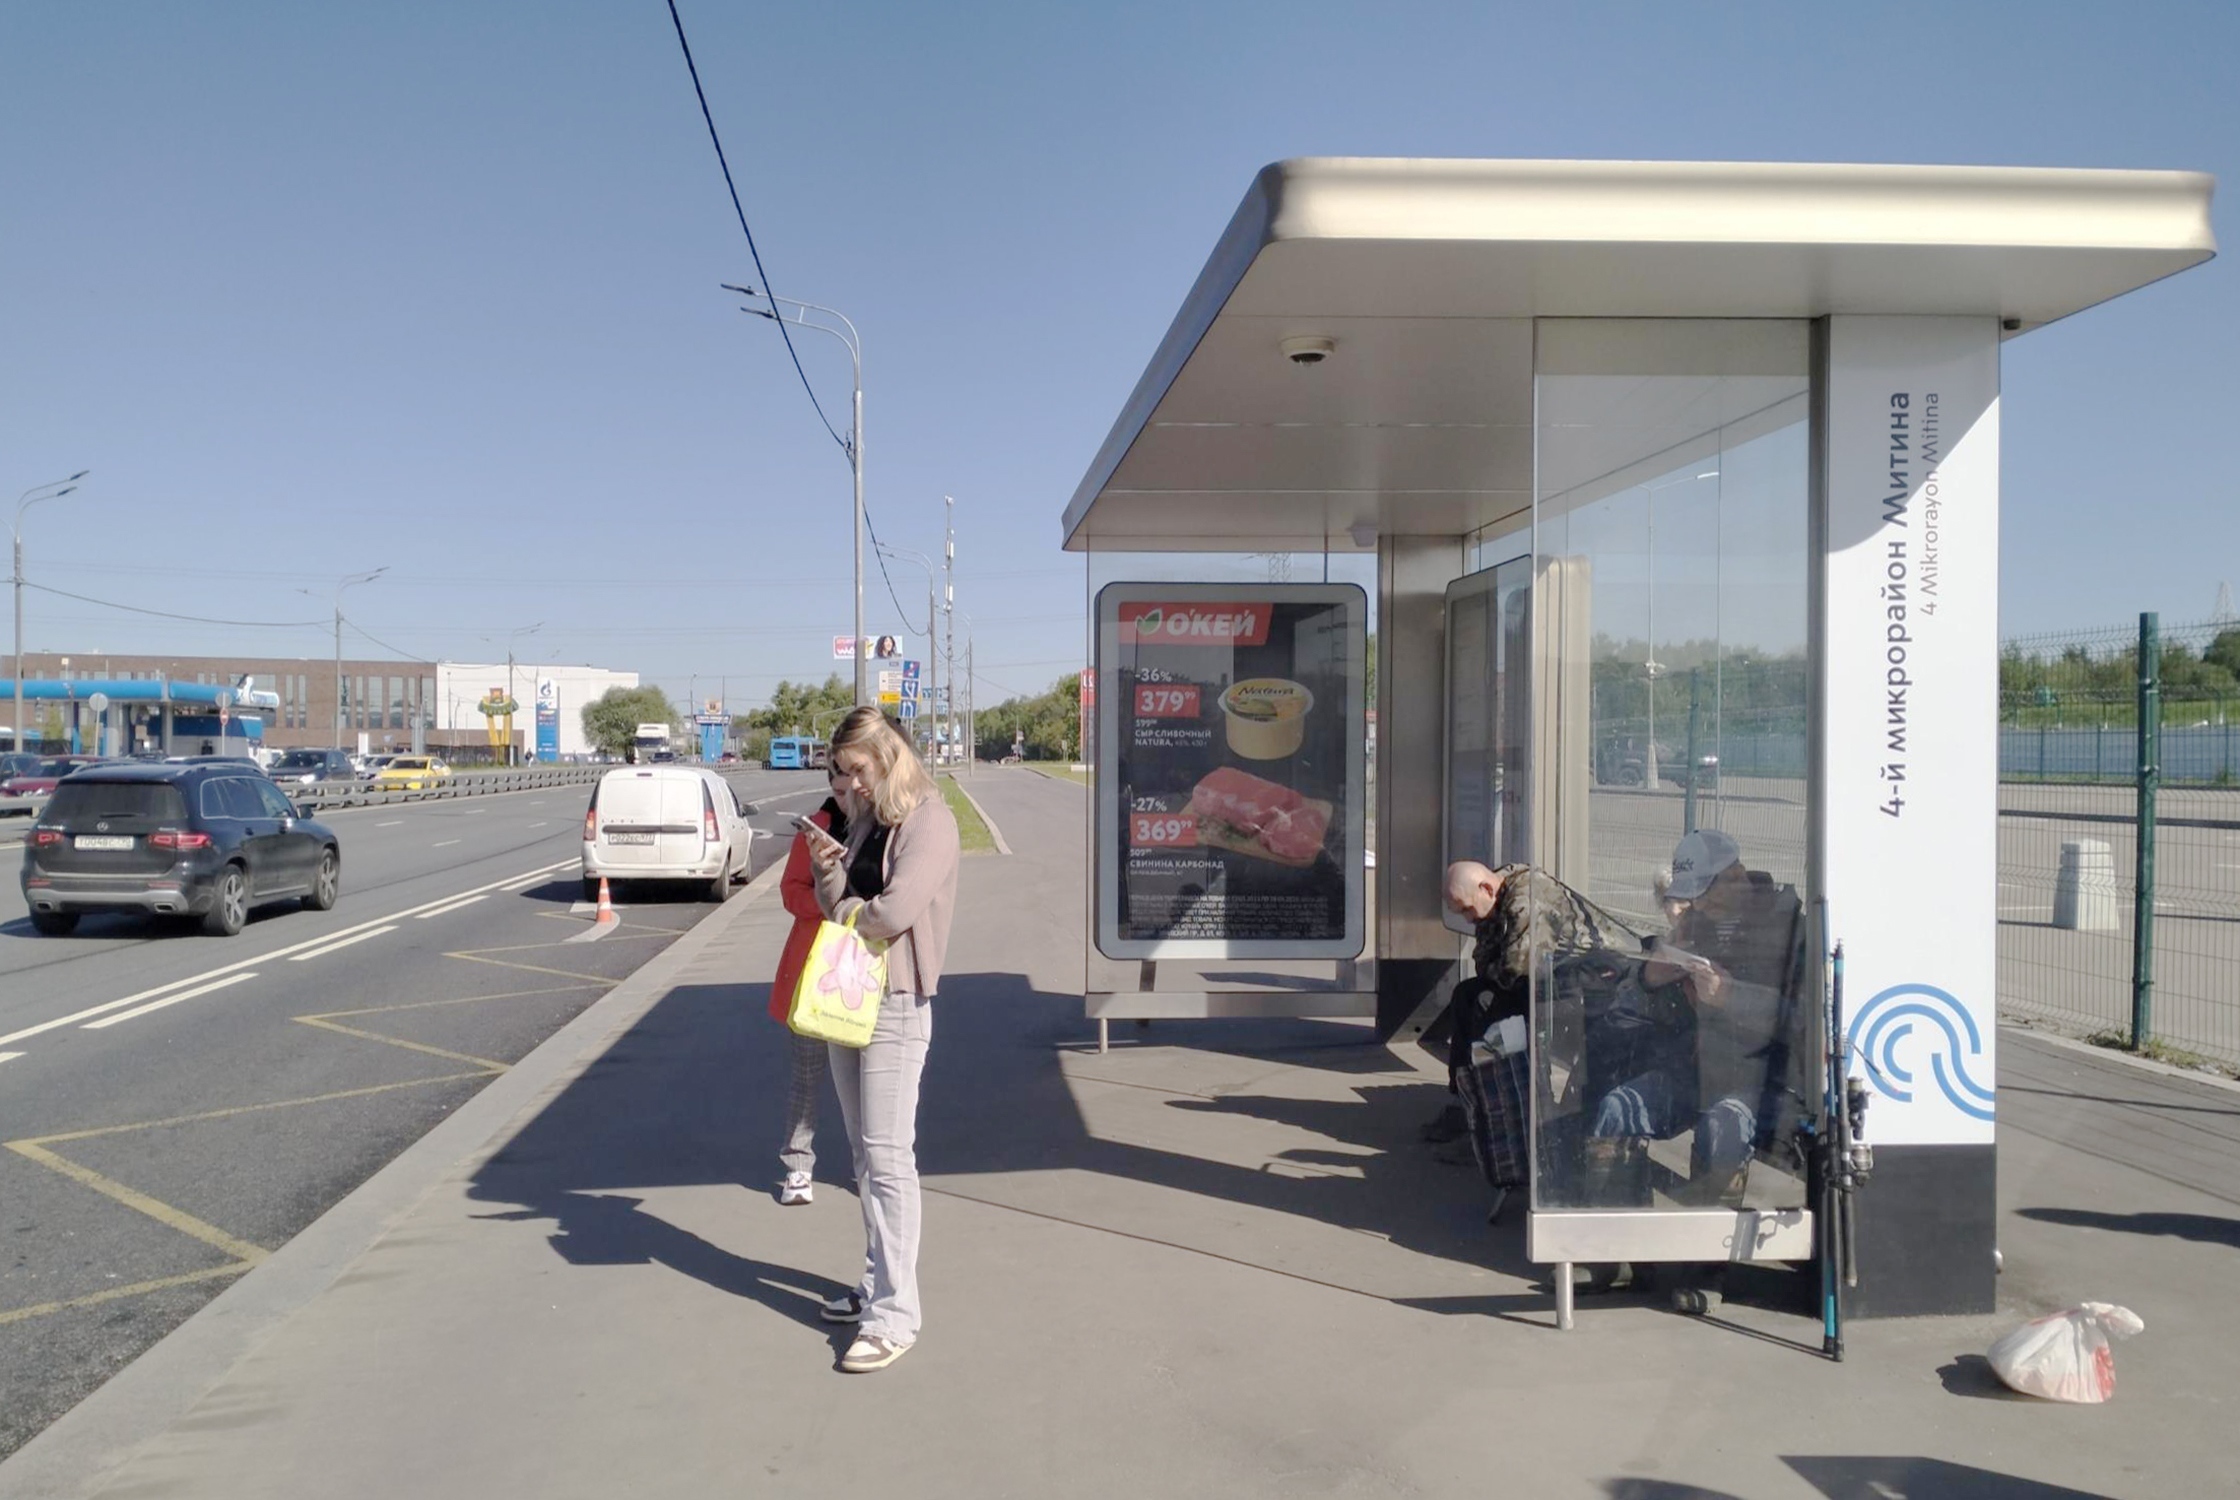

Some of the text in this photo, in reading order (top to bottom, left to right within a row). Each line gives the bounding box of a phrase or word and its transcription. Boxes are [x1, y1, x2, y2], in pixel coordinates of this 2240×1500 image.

[1919, 392, 1942, 616] 4 Mikrorayon Mitina
[1880, 392, 1913, 818] 4-й микрорайон Митина
[1135, 667, 1173, 682] -36%
[1135, 729, 1212, 739] СЫР СЛИВОЧНЫЙ
[1131, 797, 1167, 812] -27%
[1130, 859, 1225, 870] СВИНИНА КАРБОНАД
